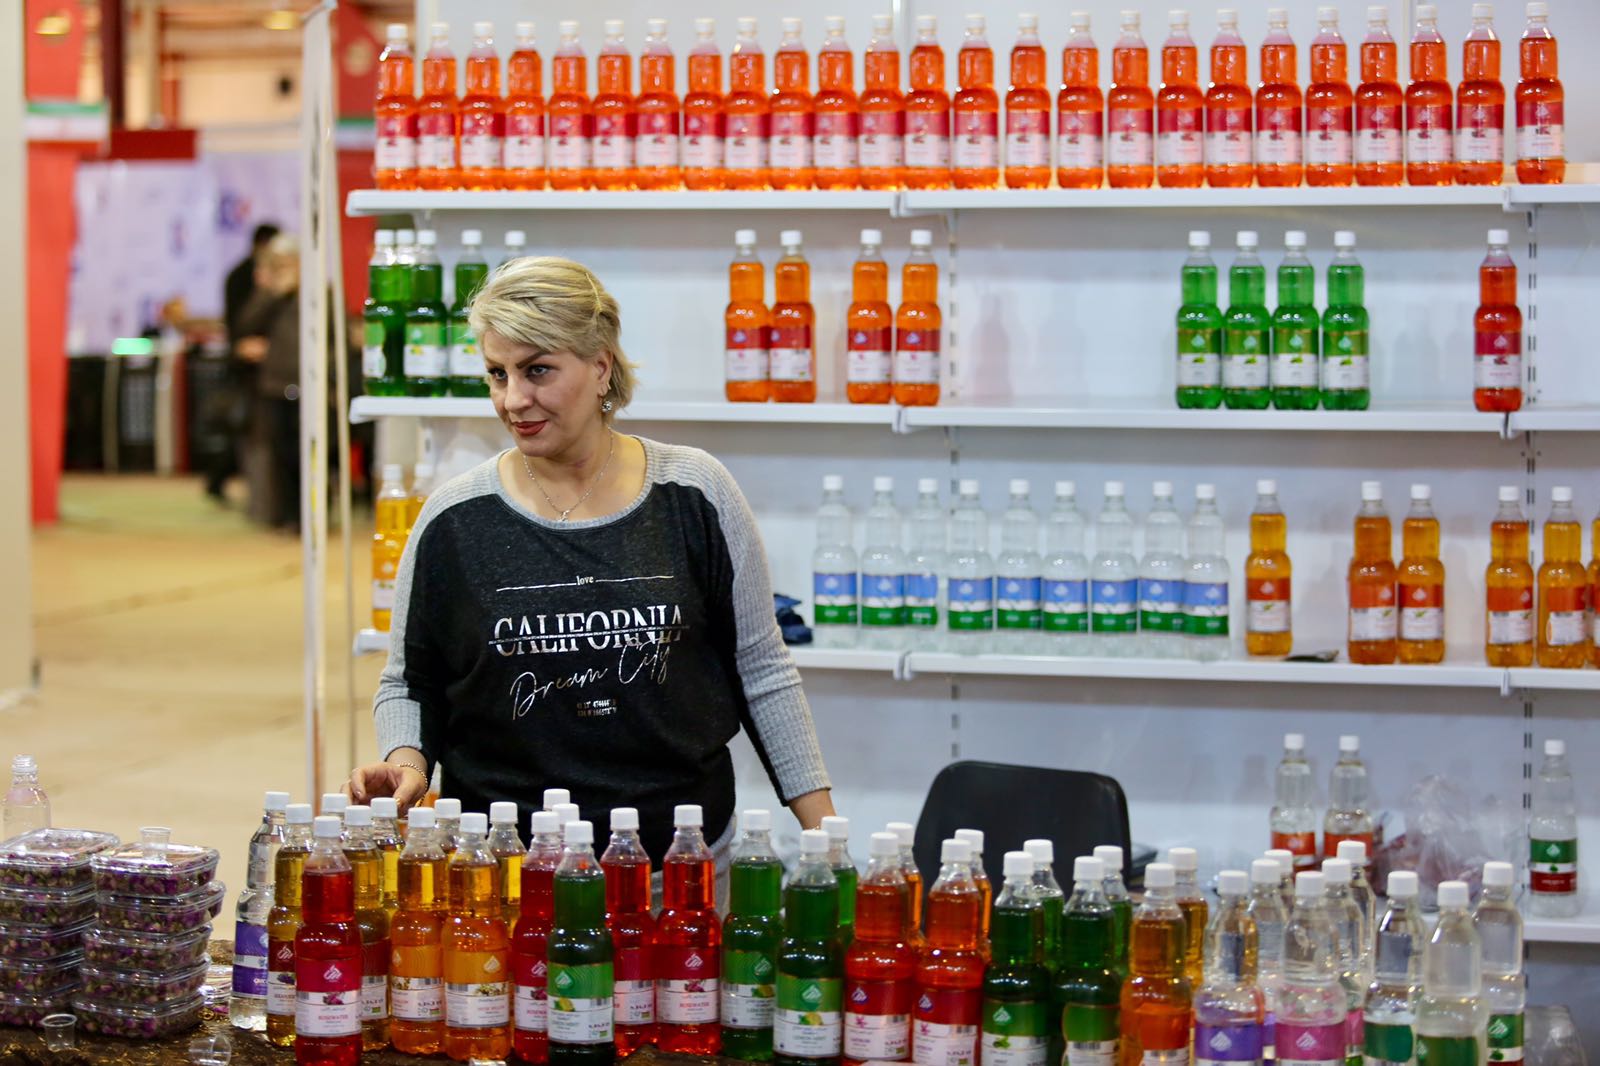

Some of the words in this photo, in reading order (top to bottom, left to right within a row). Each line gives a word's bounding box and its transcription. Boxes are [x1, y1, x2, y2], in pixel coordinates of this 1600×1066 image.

[576, 575, 595, 586] love
[493, 604, 683, 657] CALIFORNIA
[509, 667, 609, 721] Dream
[618, 637, 673, 685] City
